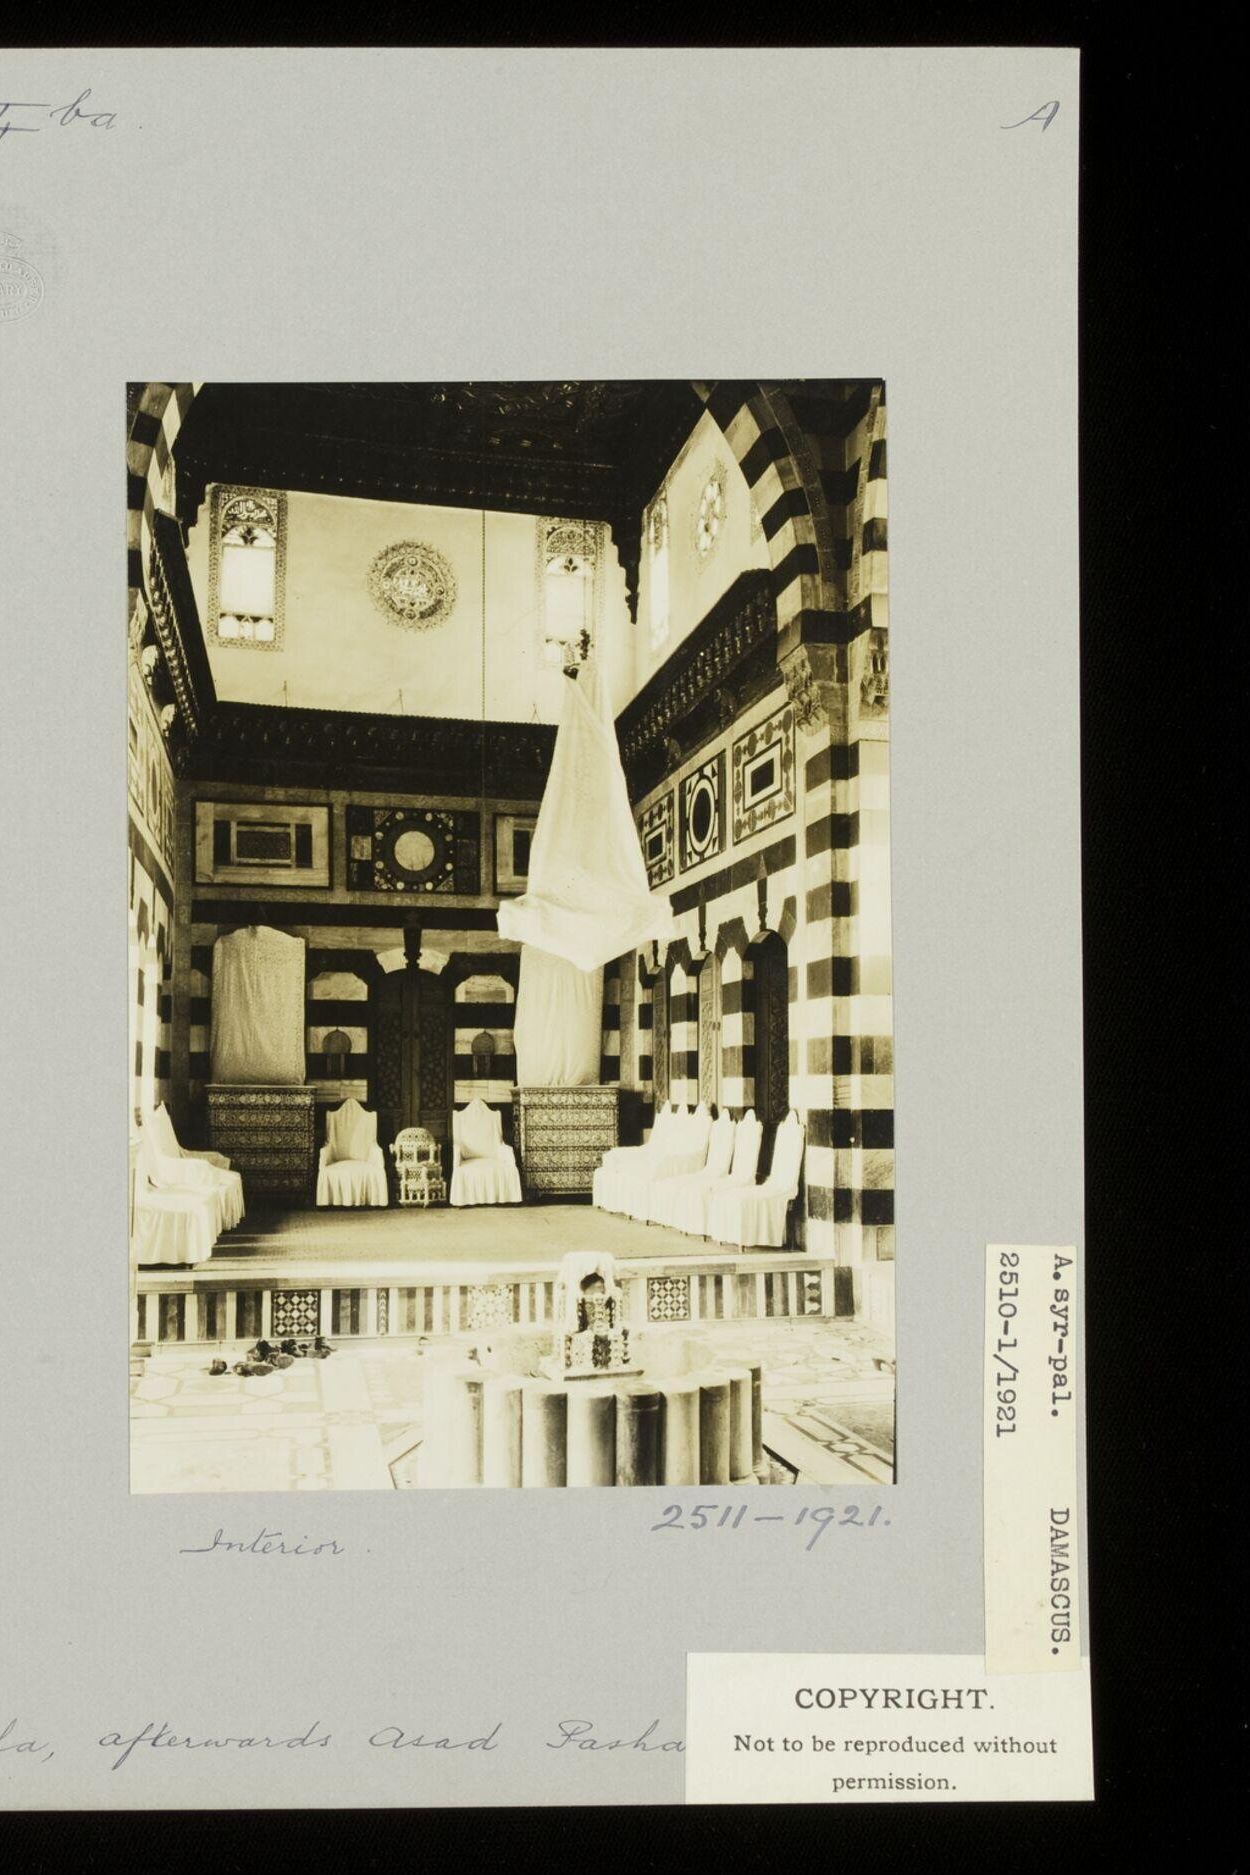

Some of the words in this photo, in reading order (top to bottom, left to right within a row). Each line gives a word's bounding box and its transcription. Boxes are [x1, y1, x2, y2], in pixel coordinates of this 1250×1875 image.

[999, 100, 1061, 133] A
[992, 1252, 1021, 1439] 2510-1/1921
[1049, 1507, 1072, 1656] DAMASCUS.
[794, 1687, 995, 1711] COPYRIGHT.
[98, 1720, 332, 1772] afterwards
[368, 1722, 503, 1751] Asad
[545, 1718, 686, 1753] Pasha
[733, 1734, 775, 1753] Not
[781, 1736, 804, 1753] to
[811, 1734, 837, 1753] be
[843, 1734, 966, 1757] reproduced
[973, 1735, 1058, 1755] without
[831, 1771, 957, 1794] permission.
